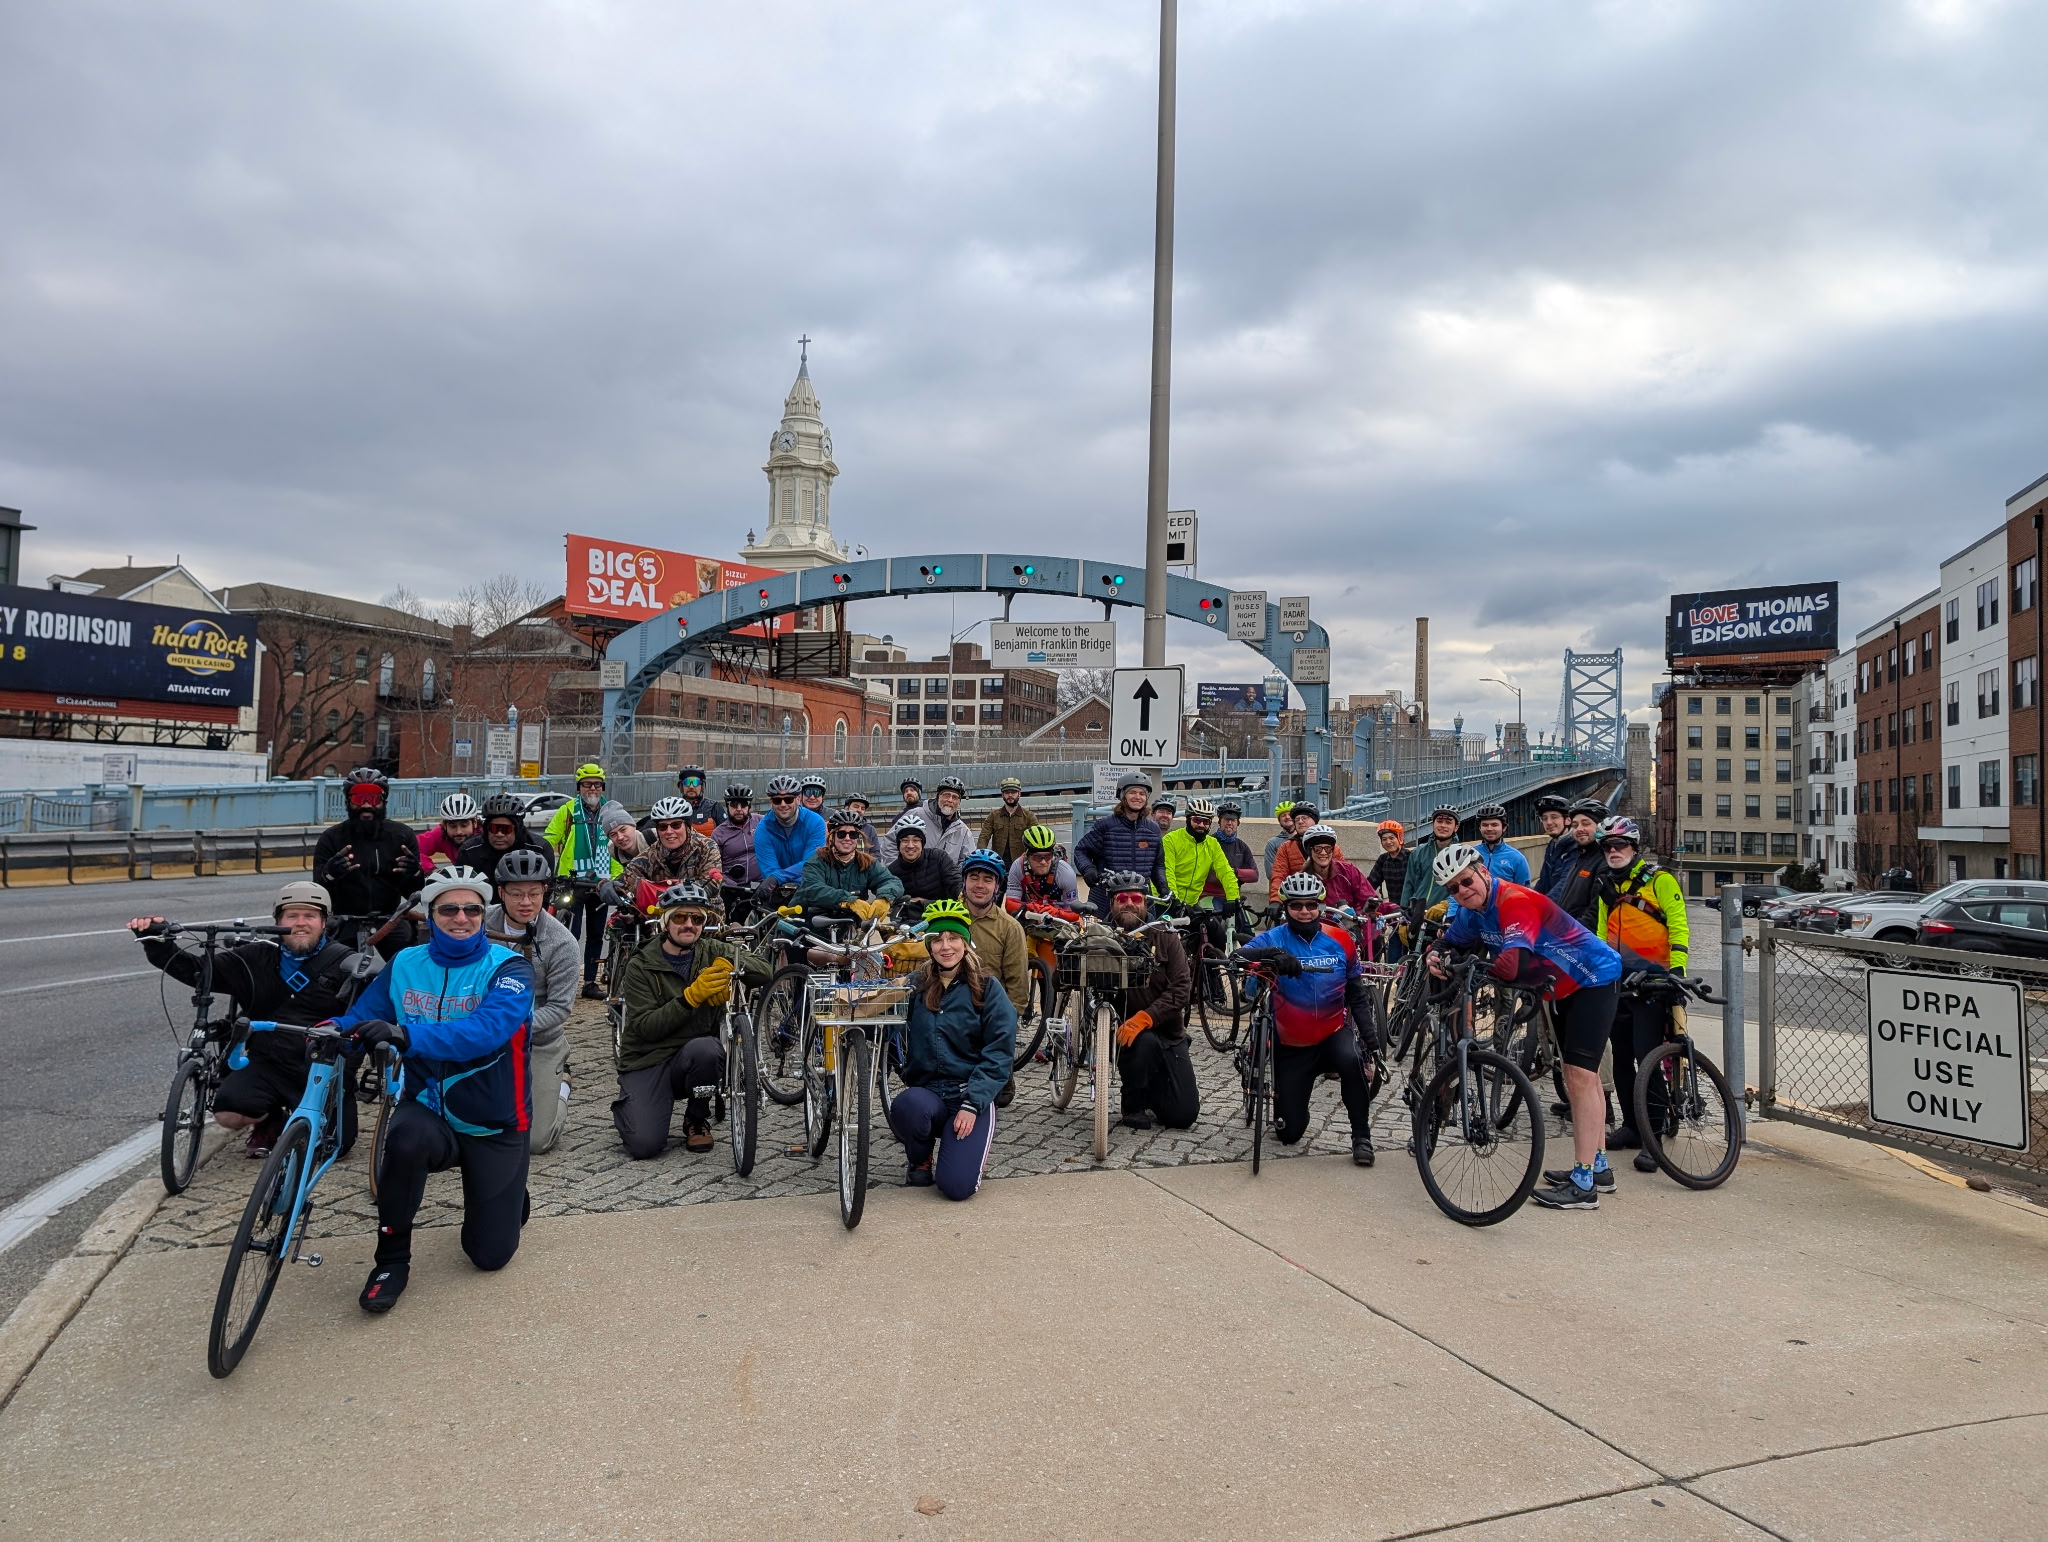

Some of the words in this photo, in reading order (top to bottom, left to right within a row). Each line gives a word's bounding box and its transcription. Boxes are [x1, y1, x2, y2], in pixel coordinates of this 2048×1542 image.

[1167, 517, 1192, 527] EED
[1168, 530, 1188, 540] MIT
[588, 548, 636, 579] BIG
[638, 557, 657, 580] $5
[587, 577, 664, 610] DEAL
[1283, 610, 1306, 618] RADAR
[1677, 611, 1683, 628] I
[1689, 603, 1739, 627] LOVE
[1746, 592, 1830, 619] THOMAS
[0, 606, 18, 635] Y
[25, 609, 131, 648] ROBINSON
[1015, 626, 1059, 637] Welcome
[1062, 626, 1071, 637] to
[1074, 626, 1090, 637] the
[1691, 615, 1813, 645] EDISON.COM
[12, 645, 26, 660] 8
[152, 624, 203, 649] Hard
[204, 631, 248, 658] Rock
[994, 639, 1038, 652] Benjamin
[1041, 639, 1078, 650] Franklin
[1080, 638, 1112, 652] Bridge
[171, 656, 195, 665] HOTEL
[203, 661, 231, 669] CASINO
[167, 684, 210, 695] ATLANTIC
[211, 687, 231, 697] CITY
[1120, 739, 1168, 757] ONLY
[1299, 957, 1339, 967] E-A-THON
[1902, 989, 1980, 1019] DRPA
[1877, 1019, 2013, 1059] OFFICIAL
[1914, 1057, 1974, 1088] USE
[1907, 1090, 1983, 1123] ONLY
